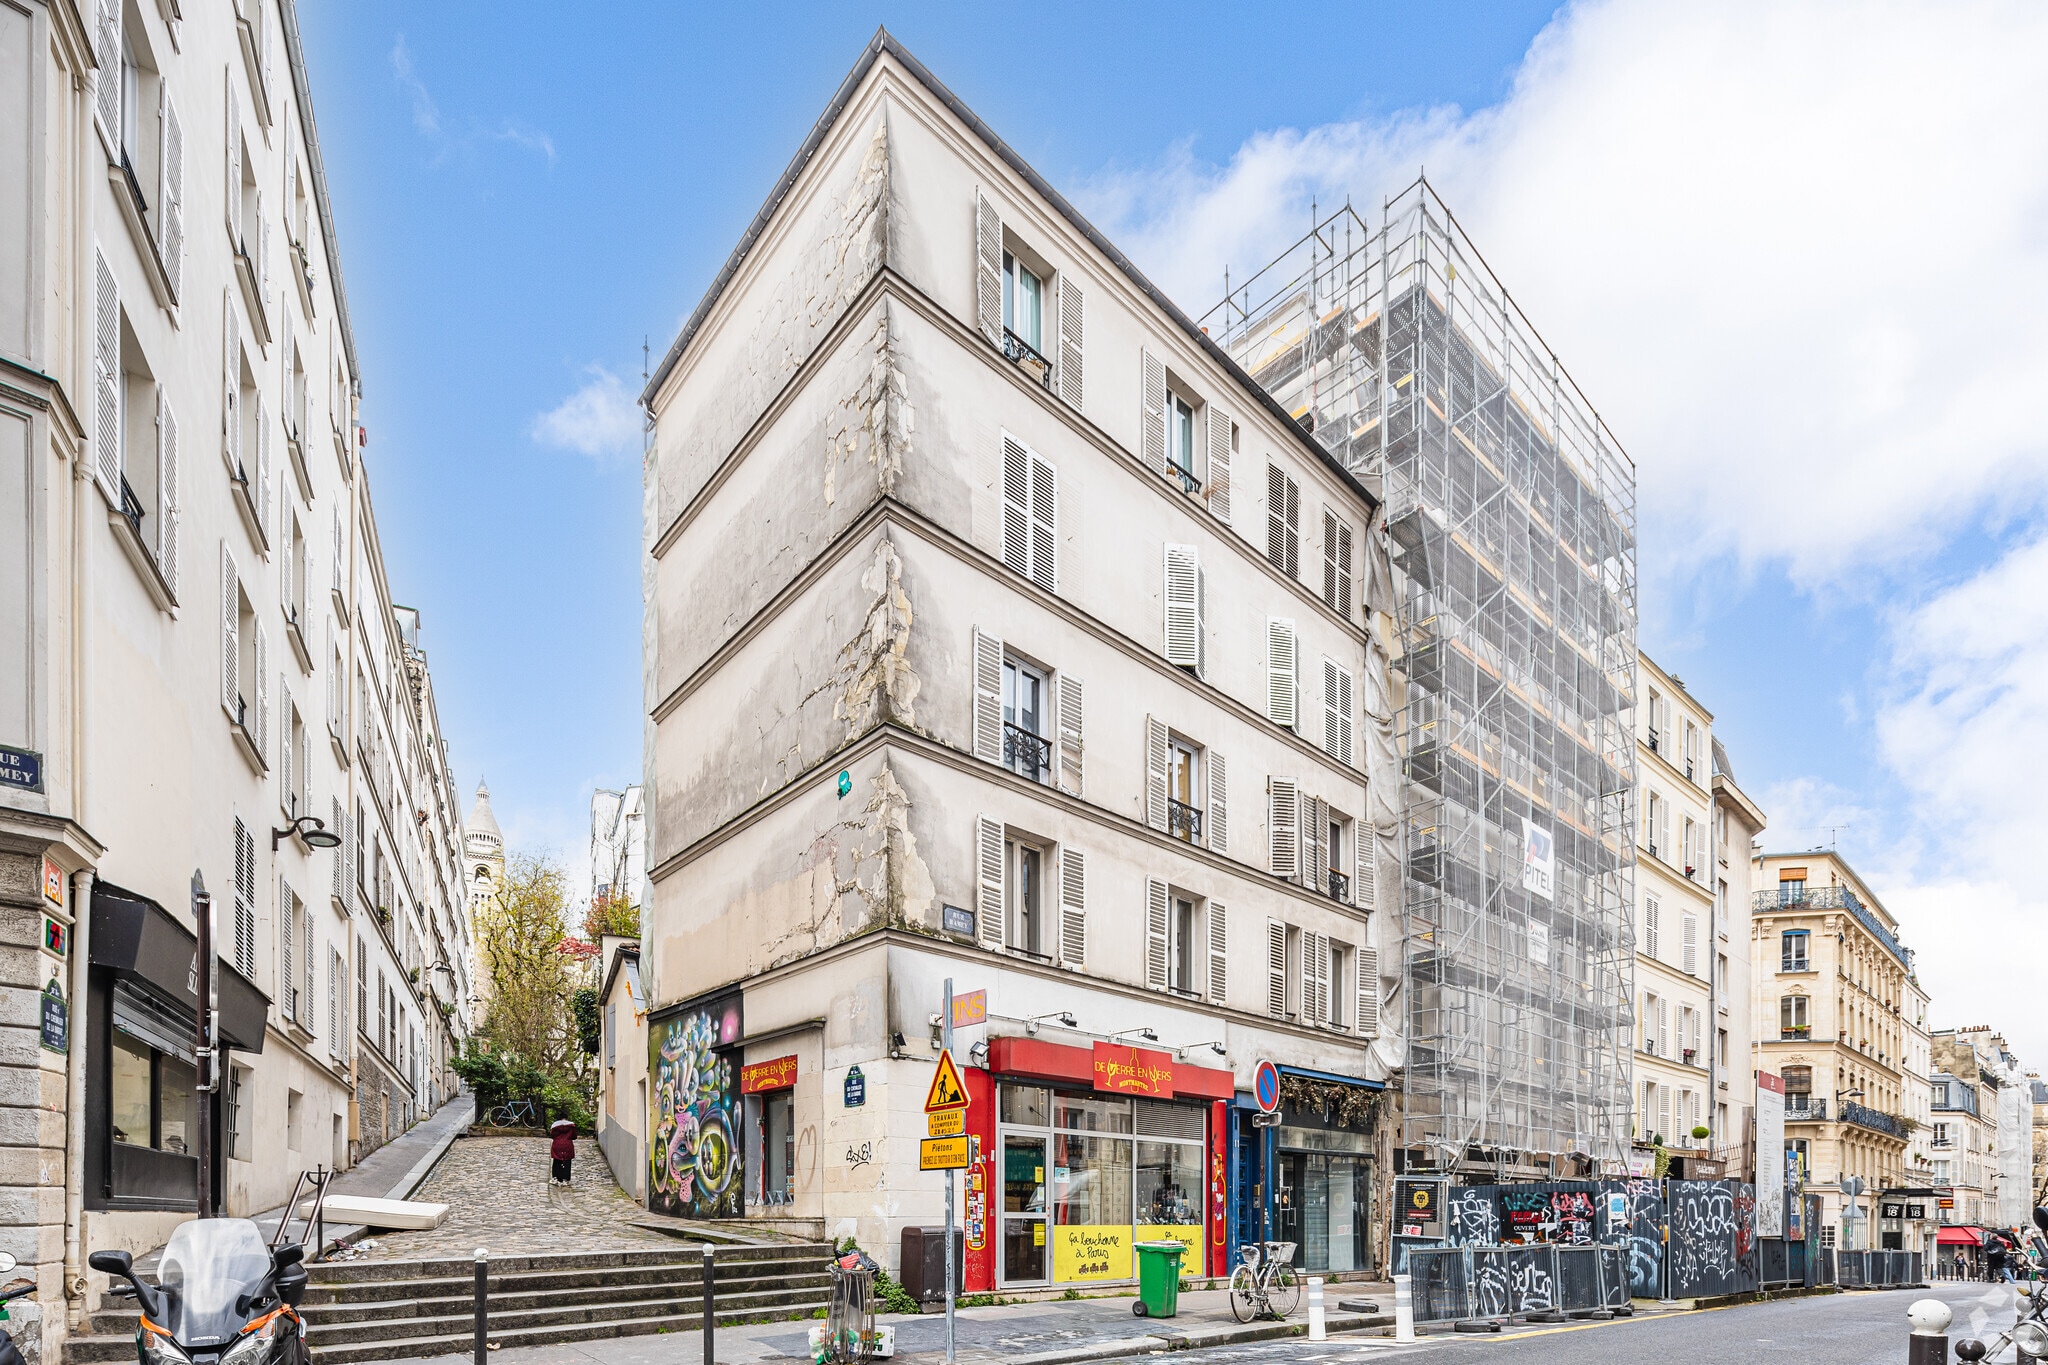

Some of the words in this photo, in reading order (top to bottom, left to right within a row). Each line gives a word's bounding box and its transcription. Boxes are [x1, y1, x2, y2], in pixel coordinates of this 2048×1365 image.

[1525, 863, 1552, 893] PITEL
[952, 911, 965, 921] RUE
[952, 995, 985, 1022] INS
[742, 1071, 749, 1081] DE
[770, 1065, 778, 1075] EN
[1094, 1061, 1106, 1073] DE
[1137, 1067, 1148, 1079] EN
[933, 1112, 958, 1122] TRAVAUX
[934, 1121, 952, 1129] COMPTER
[1887, 1208, 1898, 1217] 18
[1911, 1209, 1921, 1217] 18
[1076, 1248, 1085, 1258] à
[1087, 1246, 1109, 1259] Paris
